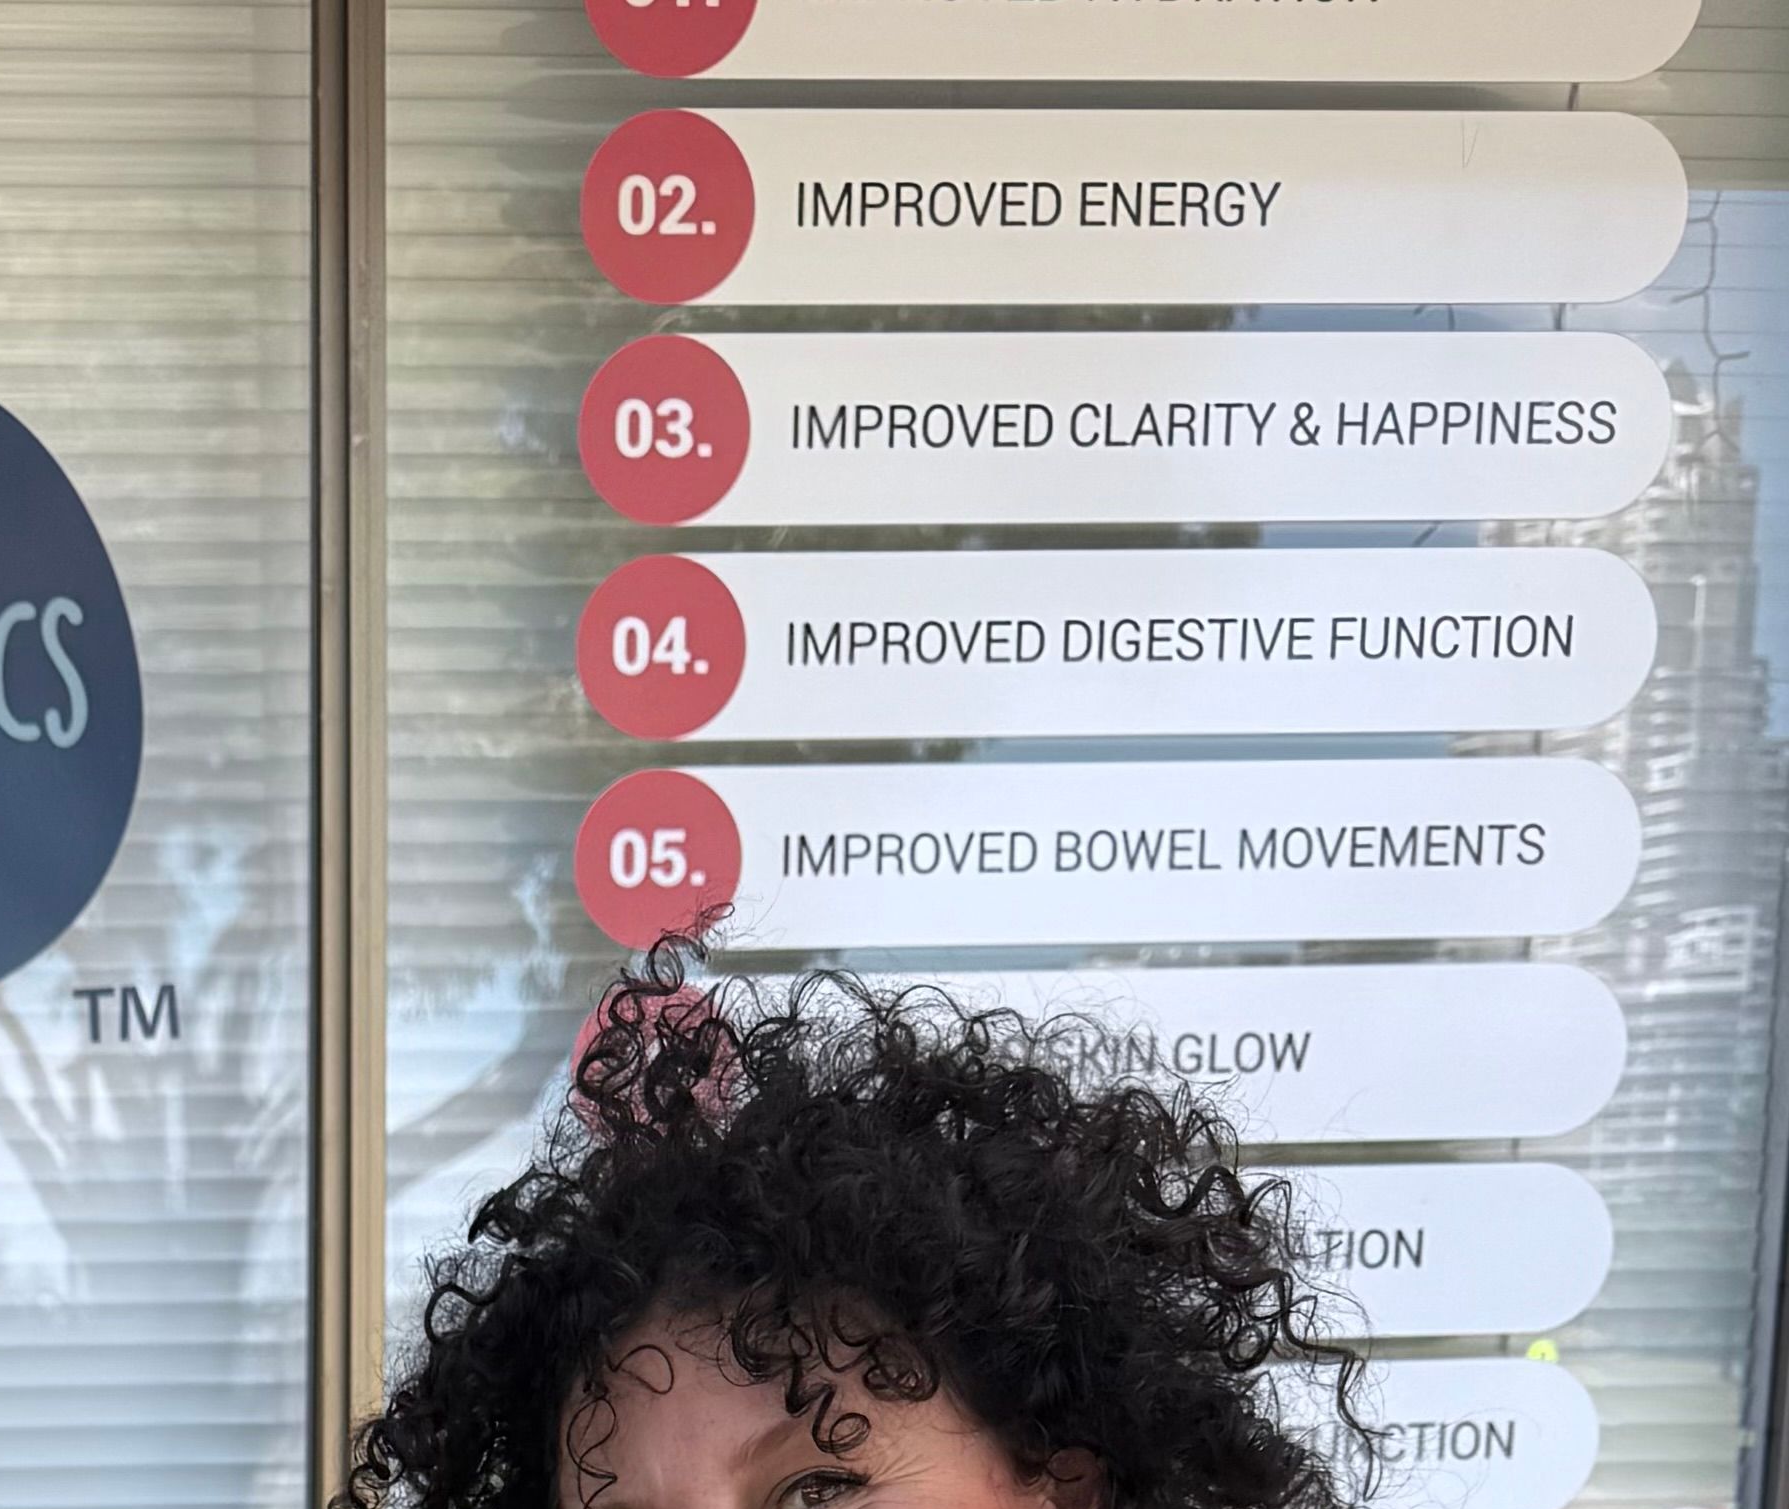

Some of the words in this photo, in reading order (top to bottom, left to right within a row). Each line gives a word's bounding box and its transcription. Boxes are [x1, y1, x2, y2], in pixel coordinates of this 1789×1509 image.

[617, 174, 717, 236] 02.
[796, 180, 1063, 229] IMPROVED
[1078, 180, 1283, 228] ENERGY
[614, 397, 713, 459] 03.
[791, 401, 1055, 450] IMPROVED
[1069, 401, 1278, 448] CLARITY
[1288, 401, 1322, 447] &
[1336, 399, 1618, 447] HAPPINESS
[611, 615, 710, 677] 04.
[787, 619, 1046, 667] IMPROVED
[1062, 616, 1316, 663] DIGESTIVE
[1329, 613, 1575, 661] FUNCTION
[609, 828, 706, 889] 05.
[782, 830, 1038, 878] IMPROVED
[1054, 828, 1222, 873] BOWEL
[1237, 822, 1547, 870] MOVEMENTS
[74, 983, 181, 1043] TM
[1172, 1032, 1312, 1075] GLOW
